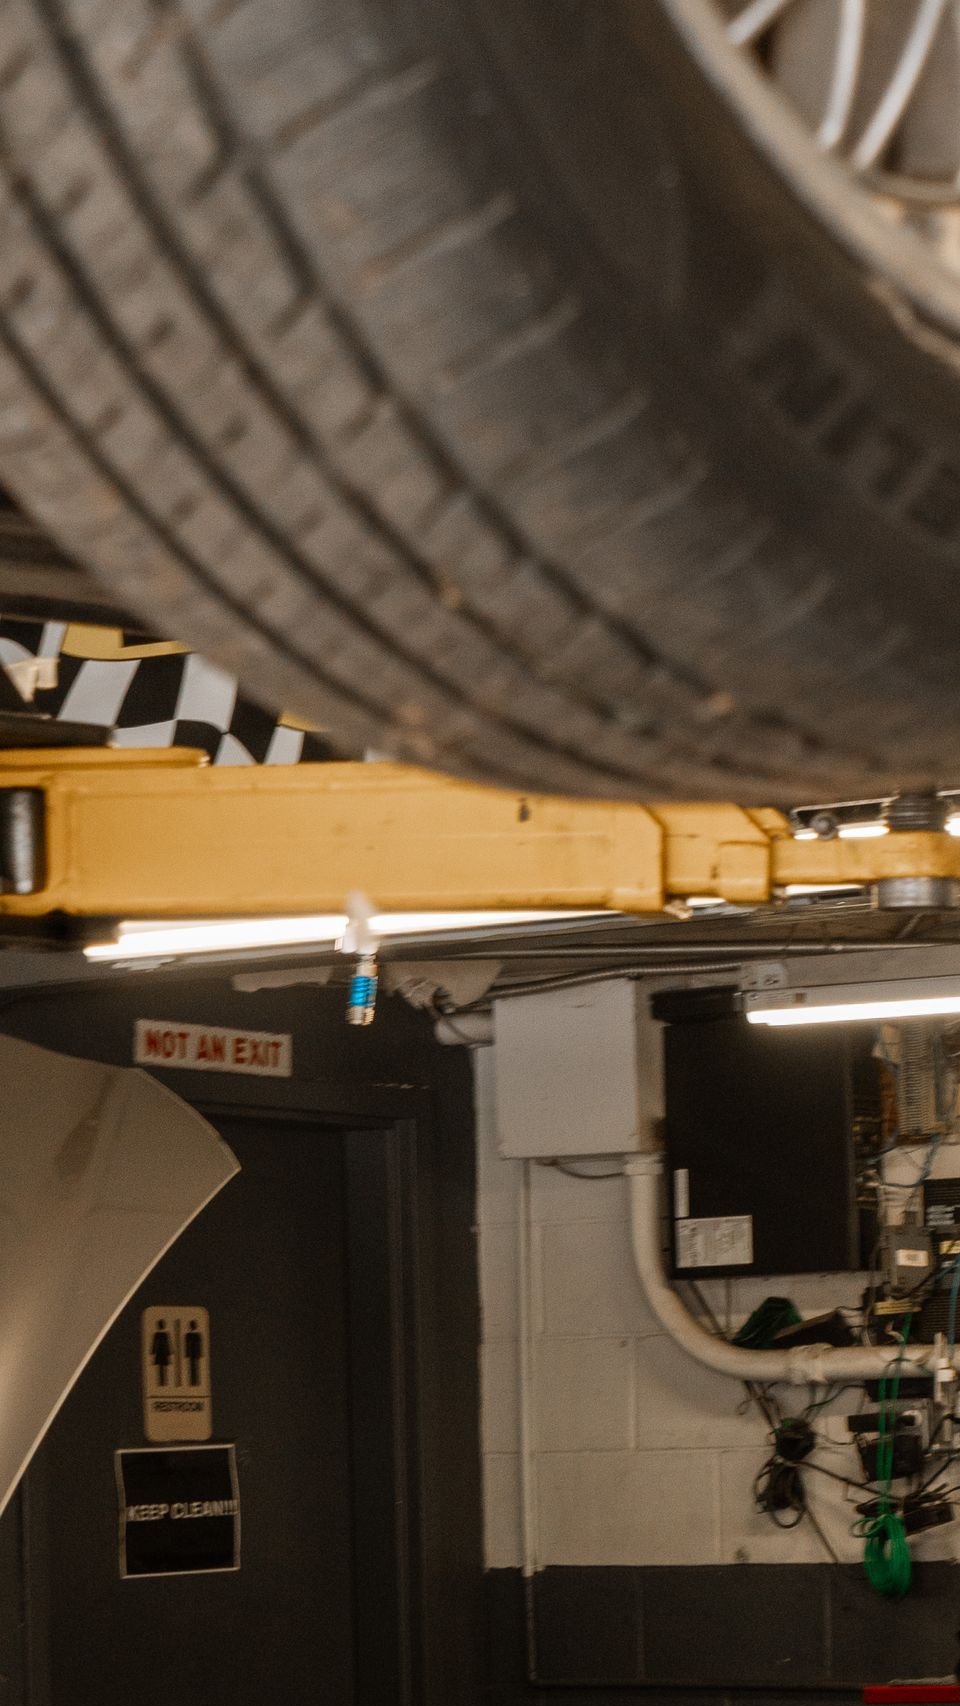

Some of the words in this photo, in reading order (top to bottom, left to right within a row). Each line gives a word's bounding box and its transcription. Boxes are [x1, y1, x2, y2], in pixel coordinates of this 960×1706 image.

[145, 1028, 190, 1060] NOT
[196, 1033, 226, 1063] AN
[233, 1037, 282, 1068] EXIT
[126, 1503, 169, 1521] KEEP
